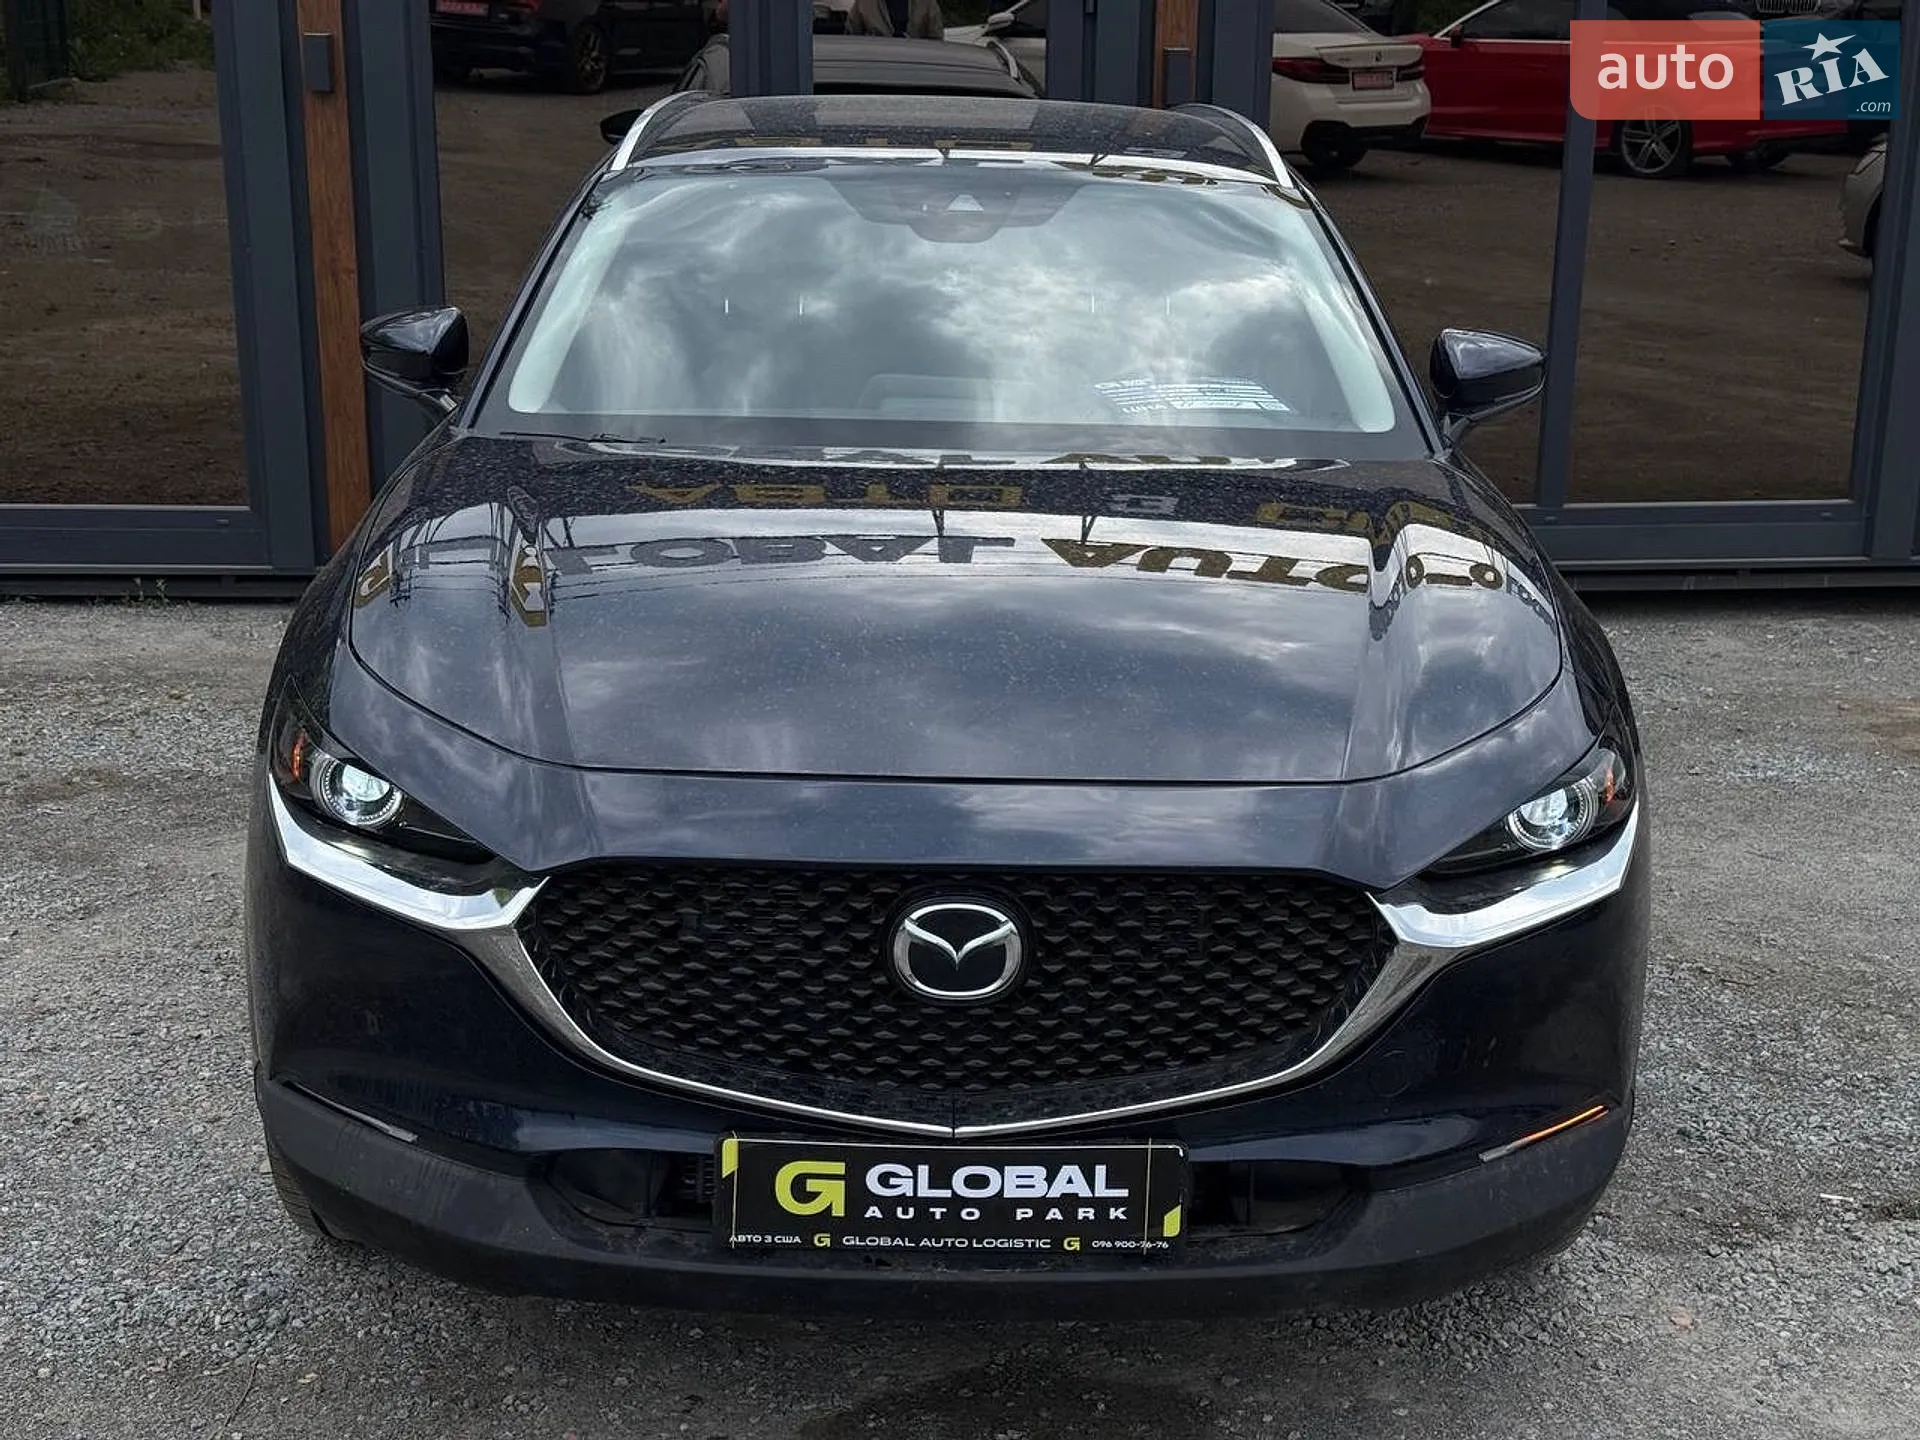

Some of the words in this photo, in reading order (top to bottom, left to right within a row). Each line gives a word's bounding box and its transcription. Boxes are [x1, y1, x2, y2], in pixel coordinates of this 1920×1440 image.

[865, 1163, 1129, 1198] GLOBAL
[864, 1205, 981, 1220] AUTO
[1015, 1207, 1128, 1221] PARK
[729, 1234, 762, 1244] АВТО
[774, 1235, 802, 1244] США
[842, 1236, 916, 1247] GLOBAL
[919, 1236, 968, 1248] AUTO
[972, 1237, 1052, 1248] LOGISTIC
[1091, 1240, 1112, 1248] 096
[1114, 1240, 1169, 1249] 900-76-76
